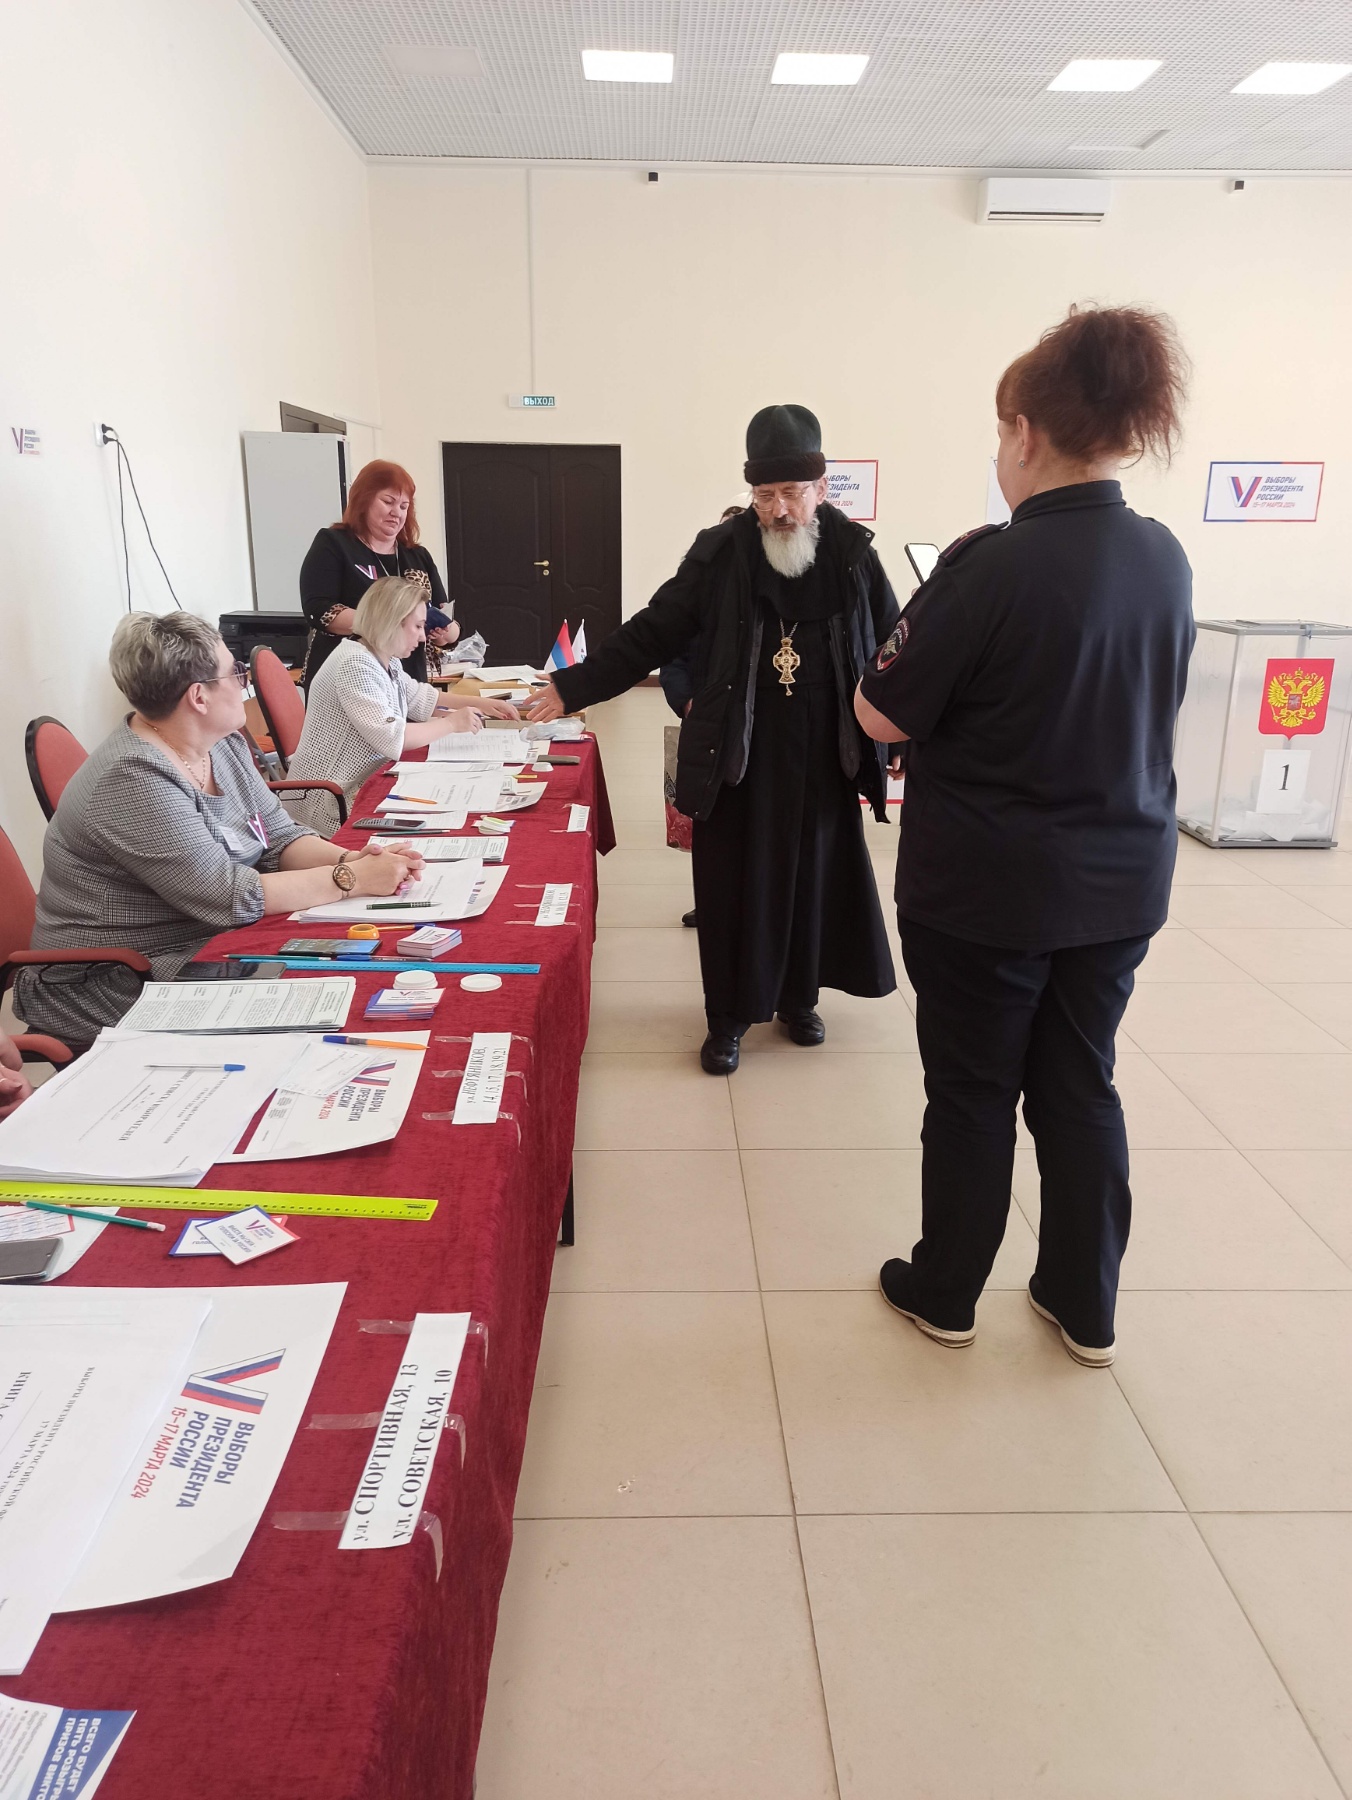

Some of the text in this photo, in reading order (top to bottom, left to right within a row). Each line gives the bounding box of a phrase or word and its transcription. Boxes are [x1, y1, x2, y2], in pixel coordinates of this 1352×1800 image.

[524, 397, 554, 406] ВЫХОД
[826, 474, 851, 482] ЫБОРЫ
[827, 483, 860, 491] ЕЗИДЕНТА
[1264, 476, 1296, 484] ВЫБОРЫ
[1255, 493, 1285, 501] РОССИИ
[1278, 764, 1290, 790] 1
[462, 1047, 488, 1095] НЕФТЯНИКОВ,
[337, 1085, 357, 1109] РОССИИ
[347, 1087, 371, 1122] ПРЕЗИДЕНТА
[368, 1089, 387, 1112] ВЫБОРЫ
[4, 1366, 95, 1507] ВЫБОРЫ ПРЕЗИДЕНТА РОССИЙСКОЙ
[19, 1430, 45, 1459] МАРТА
[145, 1434, 175, 1470] МАРТА
[169, 1410, 210, 1469] РОССИИ
[353, 1363, 419, 1541] ул. СПОРТИВНАЯ, 13
[176, 1416, 233, 1507] ПРЕЗИДЕНТА
[214, 1421, 255, 1485] ВЫБОРЫ
[392, 1369, 453, 1540] ул. СОВЕТСКАЯ, 10
[131, 1471, 156, 1499] 2024
[51, 1717, 77, 1763] ПРИЗОВ
[70, 1718, 89, 1748] ПЯТЬ
[66, 1717, 101, 1793] ВСЕГО БУДЕТ
